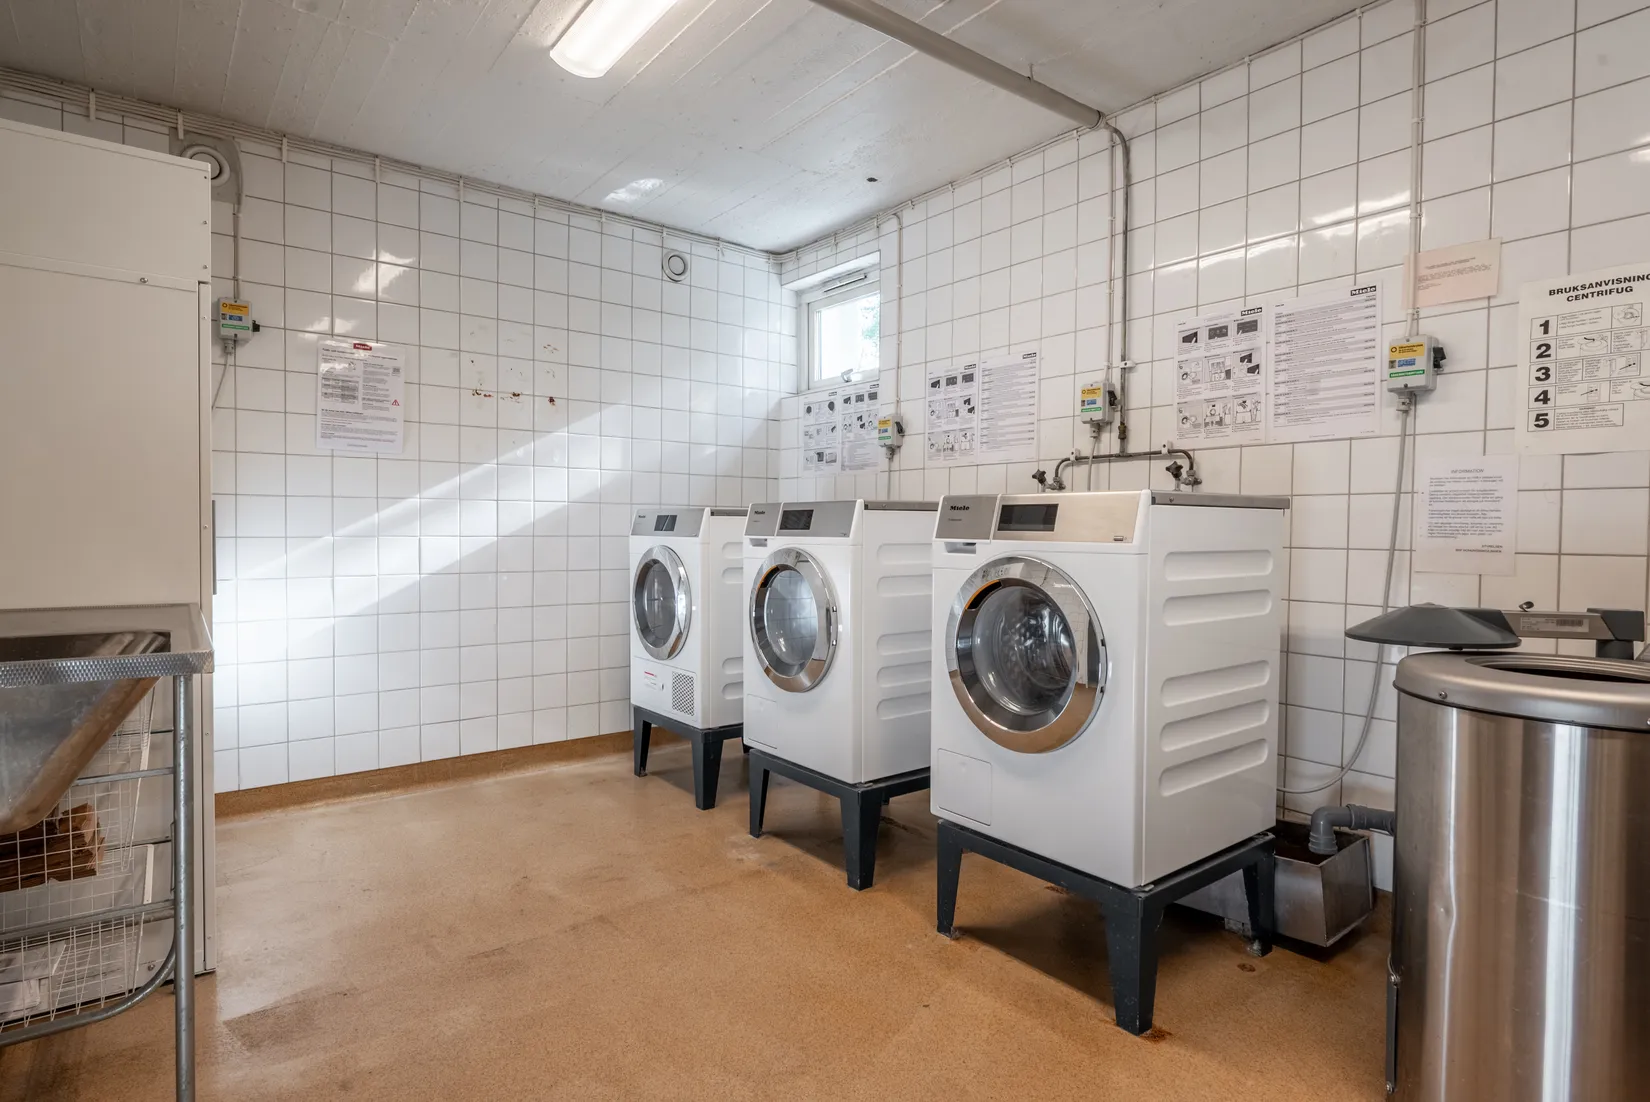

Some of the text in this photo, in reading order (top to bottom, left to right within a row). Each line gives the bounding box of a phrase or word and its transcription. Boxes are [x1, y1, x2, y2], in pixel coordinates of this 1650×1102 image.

[1351, 286, 1376, 296] Miele
[1566, 285, 1634, 302] CENTRIFUG
[1241, 307, 1262, 316] Miele
[1539, 319, 1550, 335] 1
[1535, 342, 1552, 359] 2
[1534, 366, 1551, 382] 3
[1533, 389, 1551, 405] 4
[1533, 412, 1550, 428] 5
